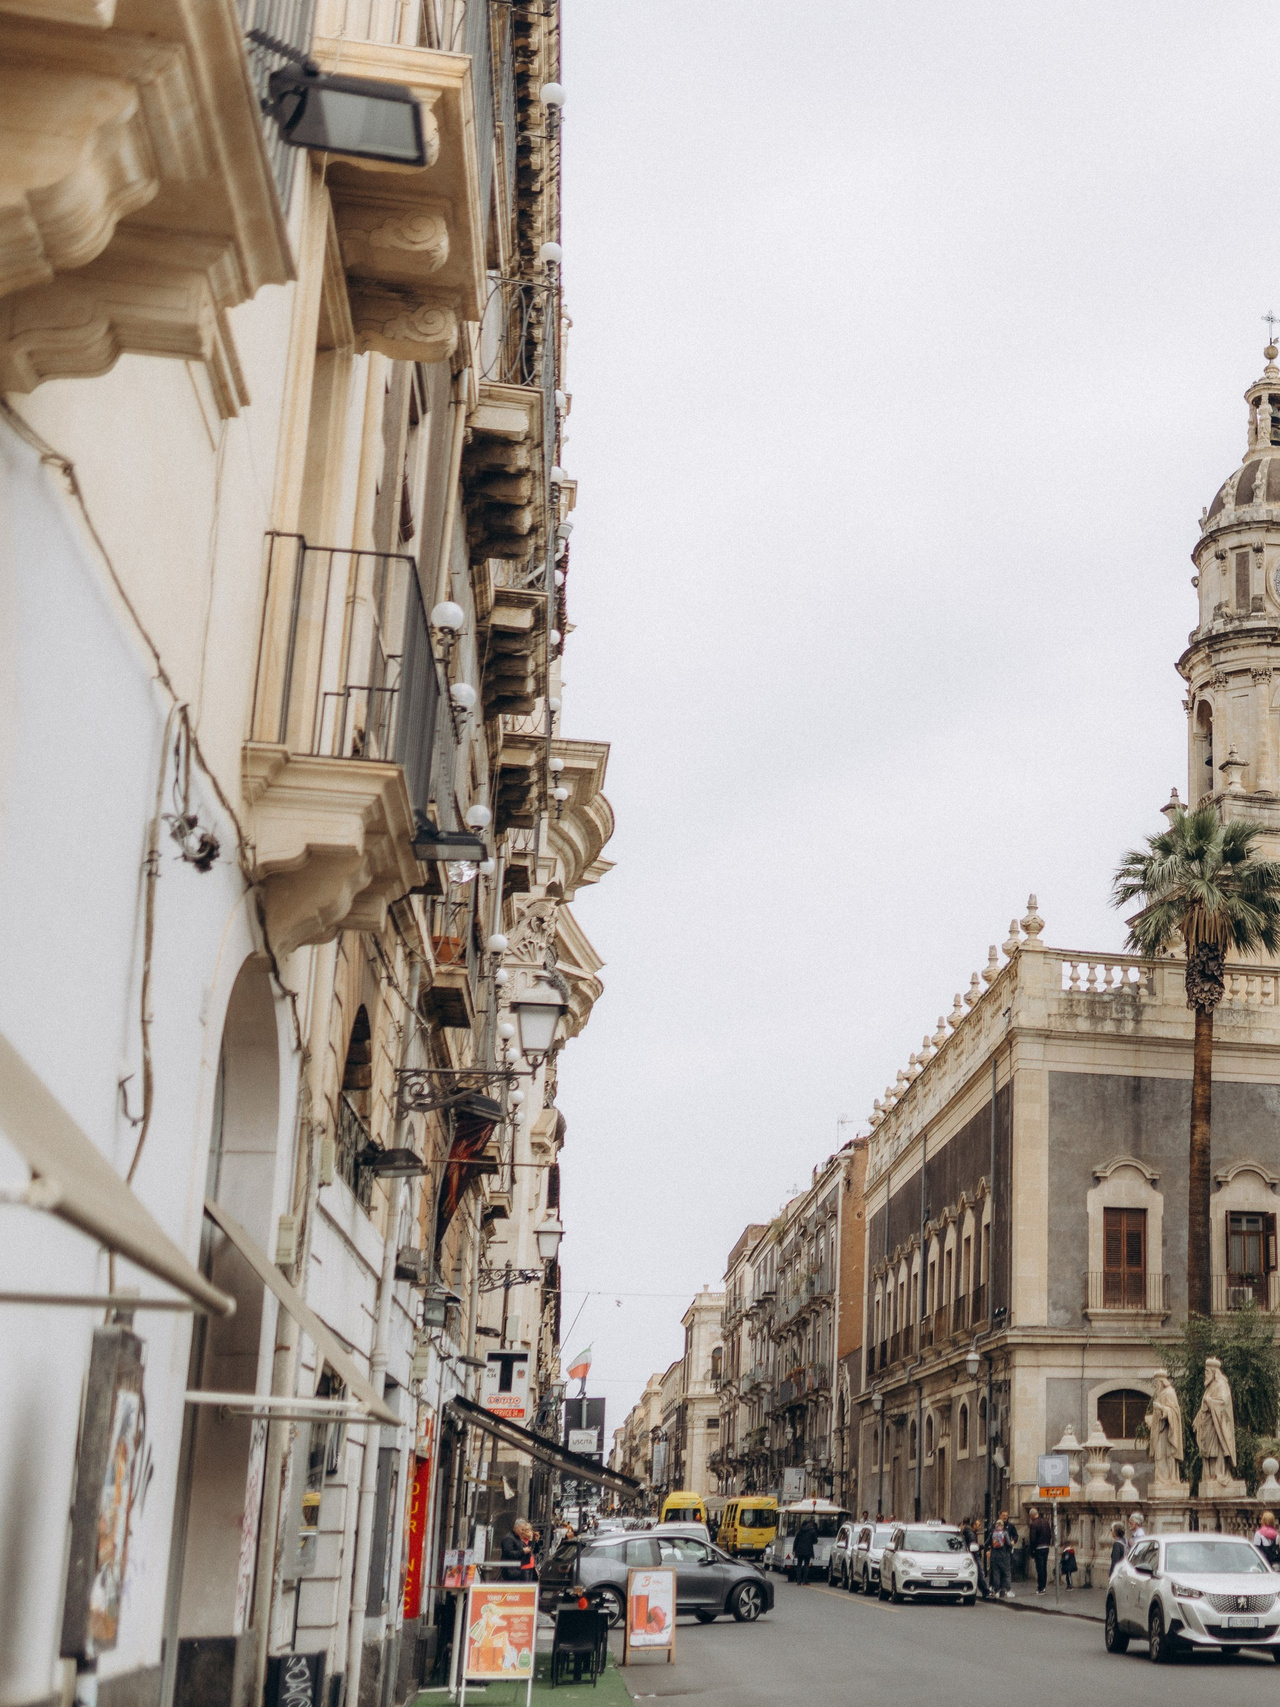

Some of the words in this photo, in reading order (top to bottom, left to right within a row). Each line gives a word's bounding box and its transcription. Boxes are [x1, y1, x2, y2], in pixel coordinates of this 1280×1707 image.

[487, 1353, 528, 1392] T
[487, 1396, 521, 1405] LOTTO
[1045, 1459, 1064, 1484] P
